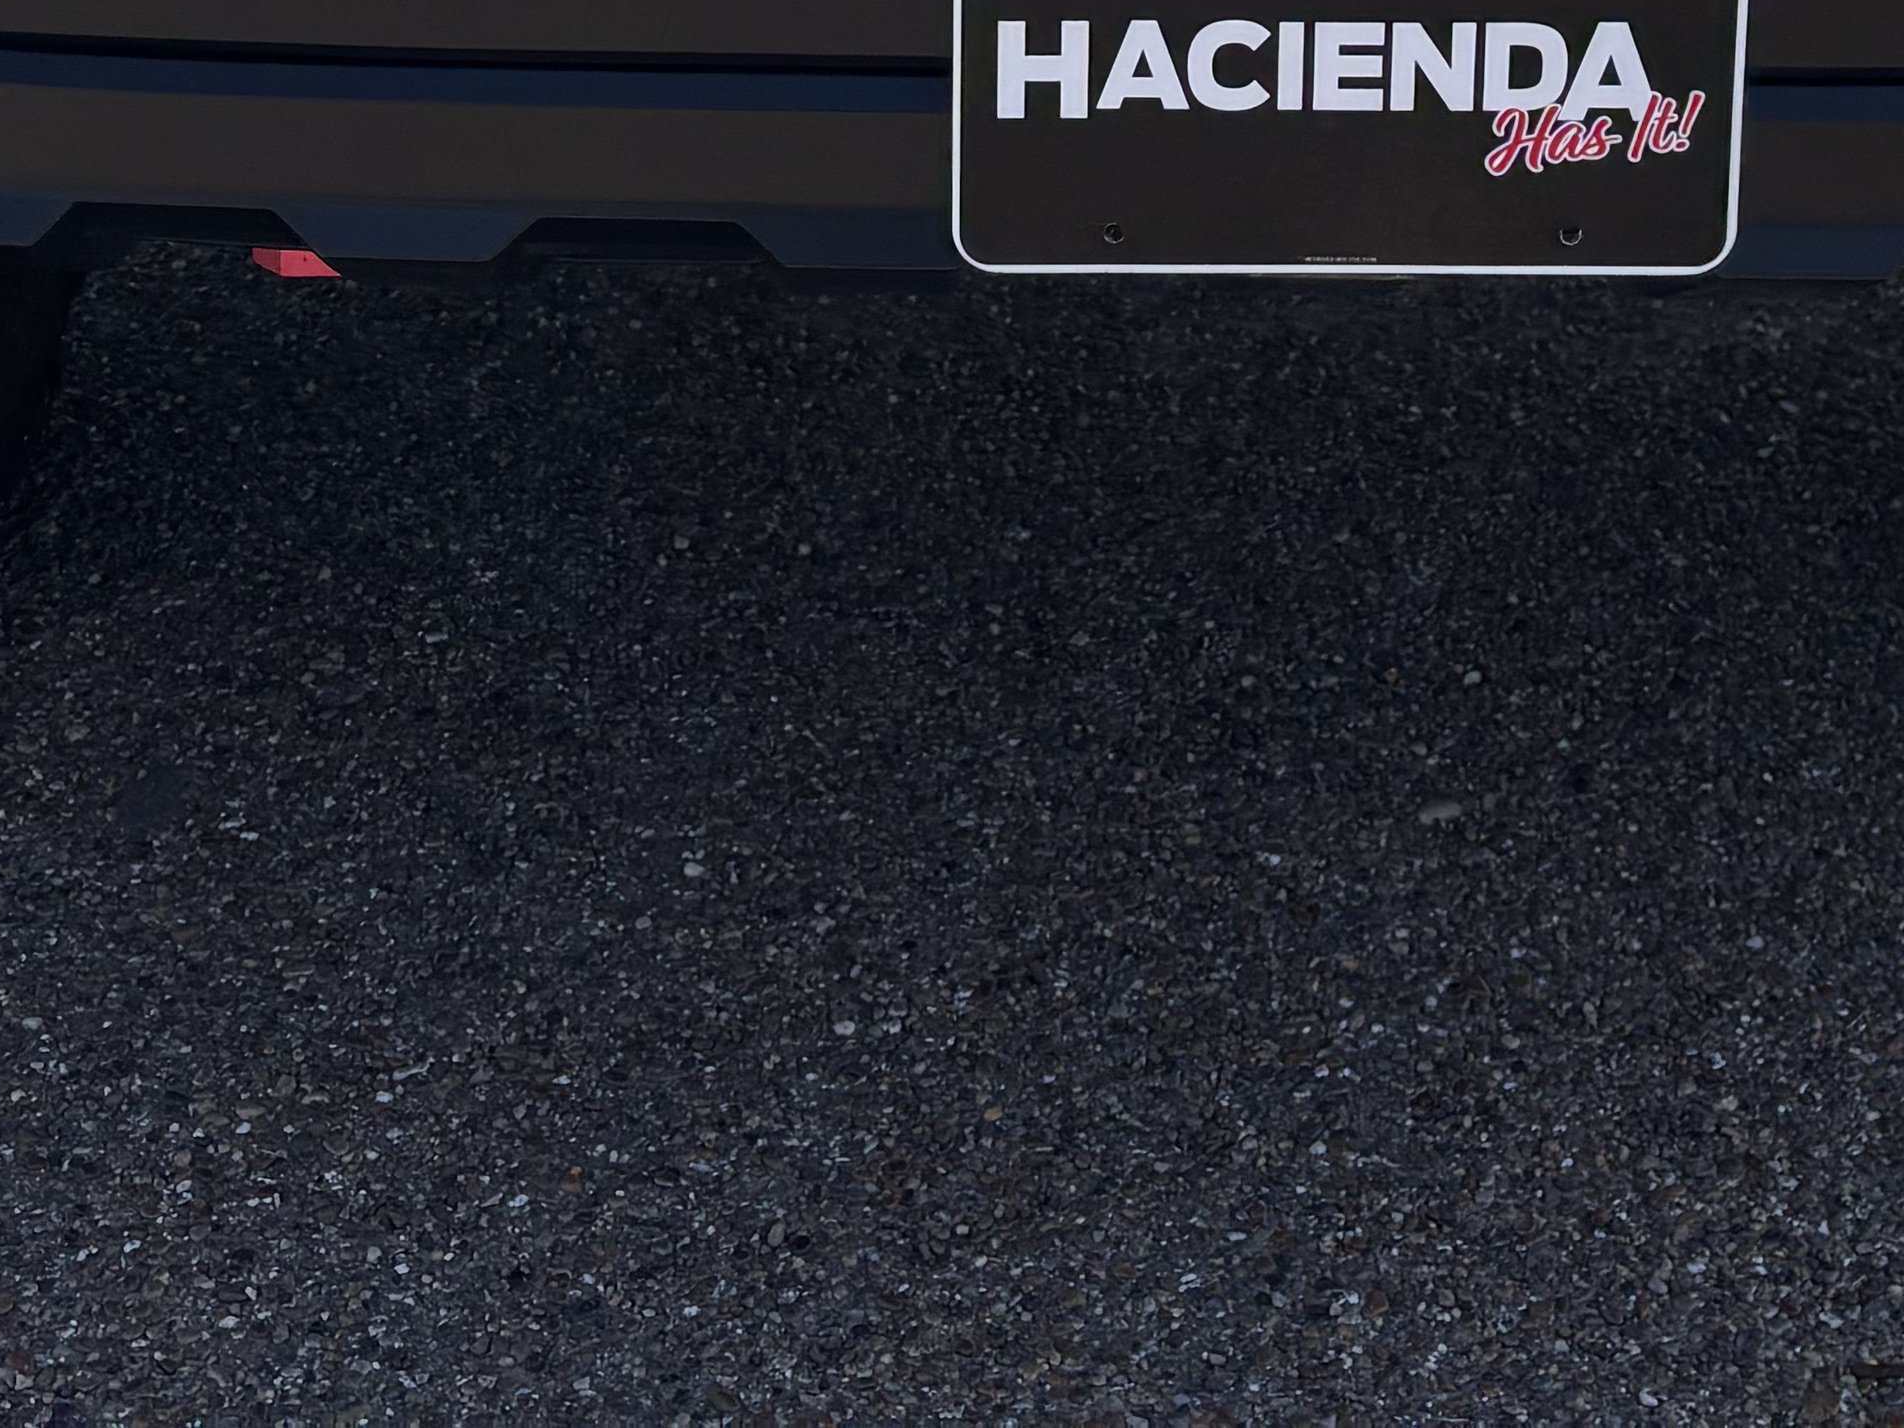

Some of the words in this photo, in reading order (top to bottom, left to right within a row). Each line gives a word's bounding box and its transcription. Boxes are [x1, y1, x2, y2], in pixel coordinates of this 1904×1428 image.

[996, 19, 1657, 122] HACIENDA
[1485, 103, 1624, 176] Has
[1627, 90, 1706, 163] It!
